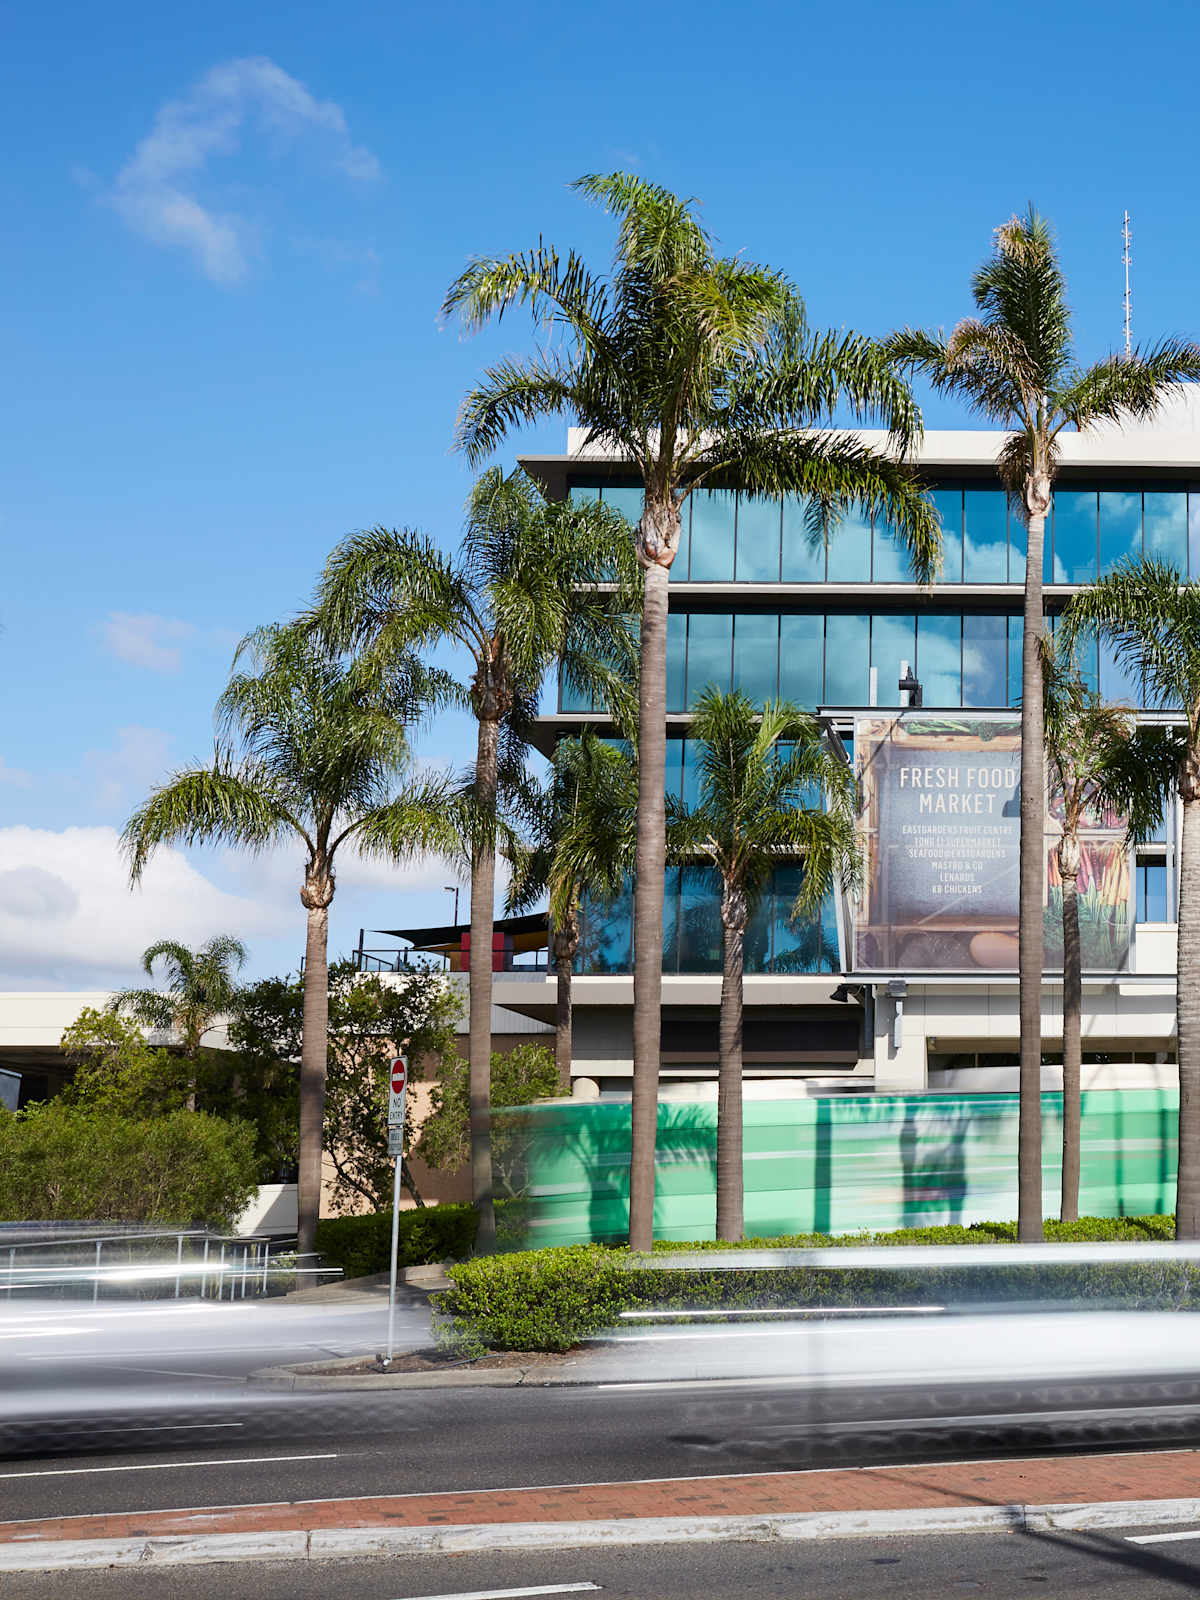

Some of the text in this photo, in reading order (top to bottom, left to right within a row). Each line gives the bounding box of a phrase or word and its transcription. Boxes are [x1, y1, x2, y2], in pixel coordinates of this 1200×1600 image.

[900, 767, 1016, 788] FRESH FOOD
[919, 793, 996, 814] MARKET
[392, 1098, 401, 1108] NO
[389, 1112, 403, 1121] ENTRY
